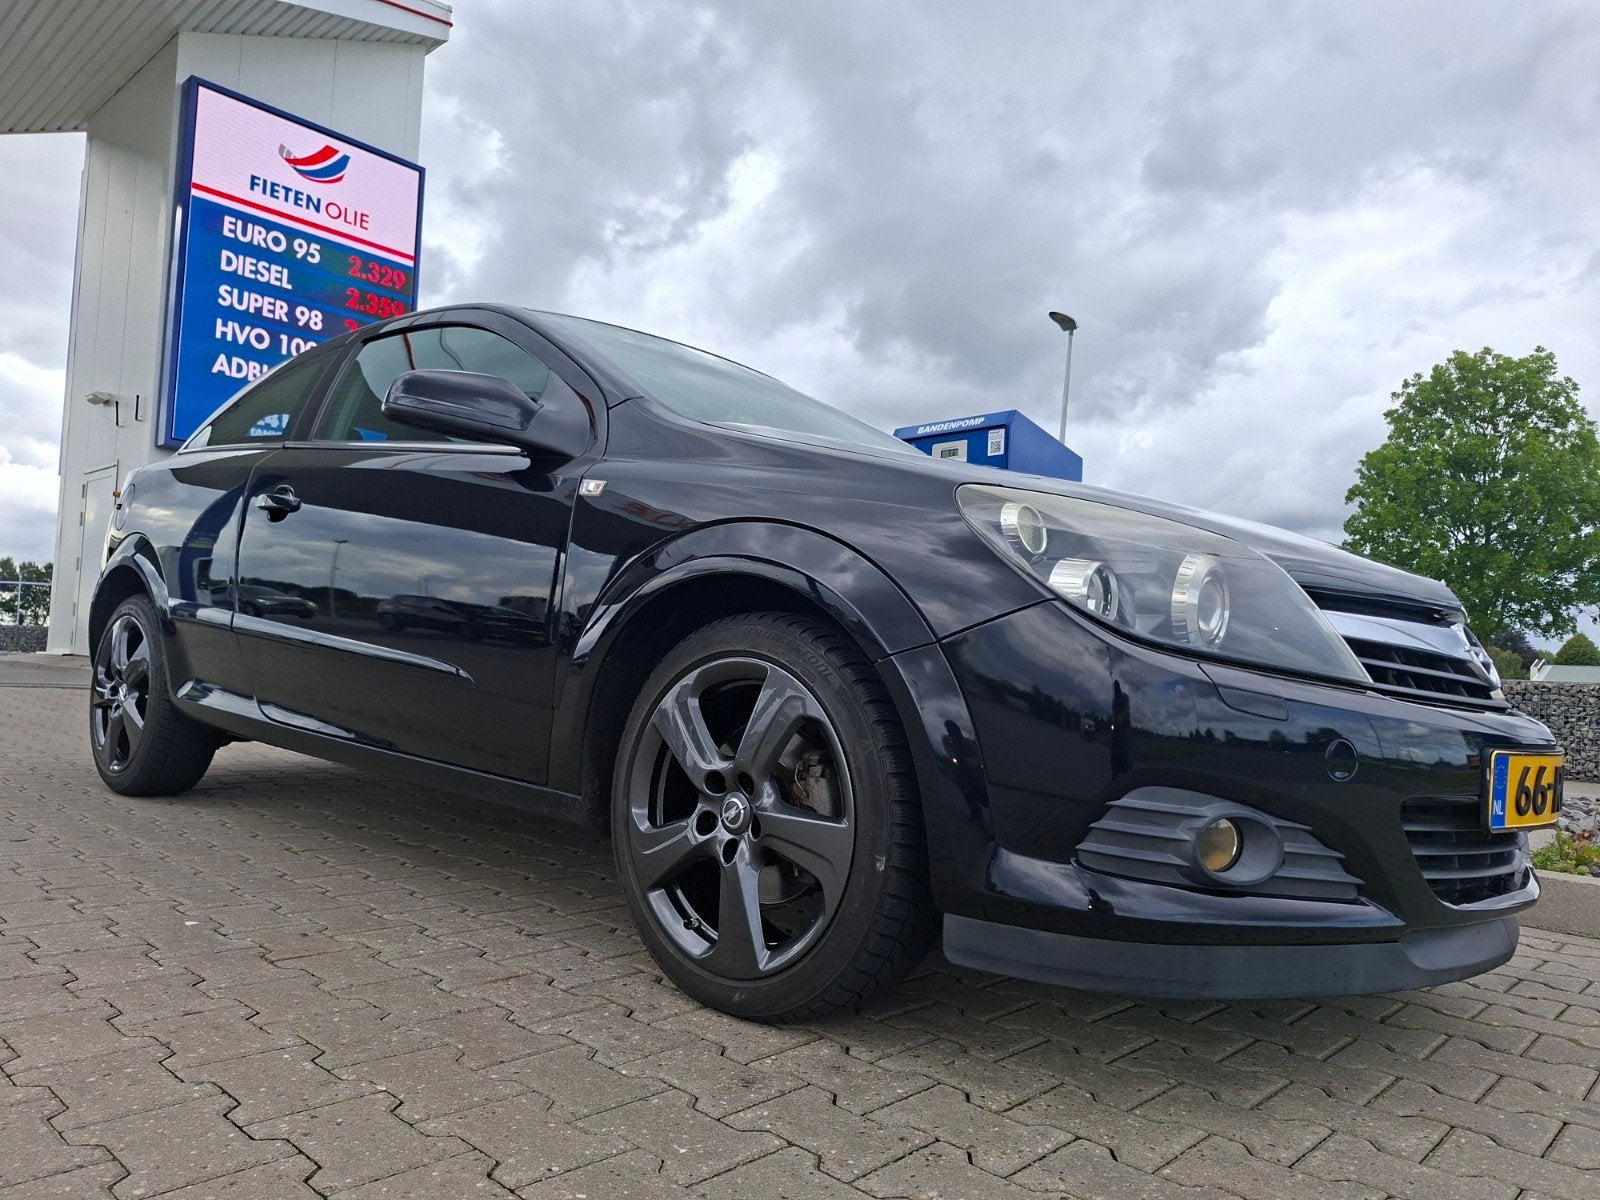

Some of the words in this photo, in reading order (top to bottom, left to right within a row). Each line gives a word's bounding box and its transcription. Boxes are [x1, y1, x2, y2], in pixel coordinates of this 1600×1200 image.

[249, 174, 321, 214] FIETEN
[325, 201, 370, 231] OLIE
[220, 249, 292, 290] DIESEL
[223, 215, 286, 252] EURO
[293, 239, 321, 264] 95
[348, 256, 406, 290] 2.329
[217, 284, 288, 323] SUPER
[295, 306, 322, 331] 98
[215, 317, 270, 350] HVO
[917, 417, 985, 434] BANDENPOMP
[1493, 799, 1503, 815] NL
